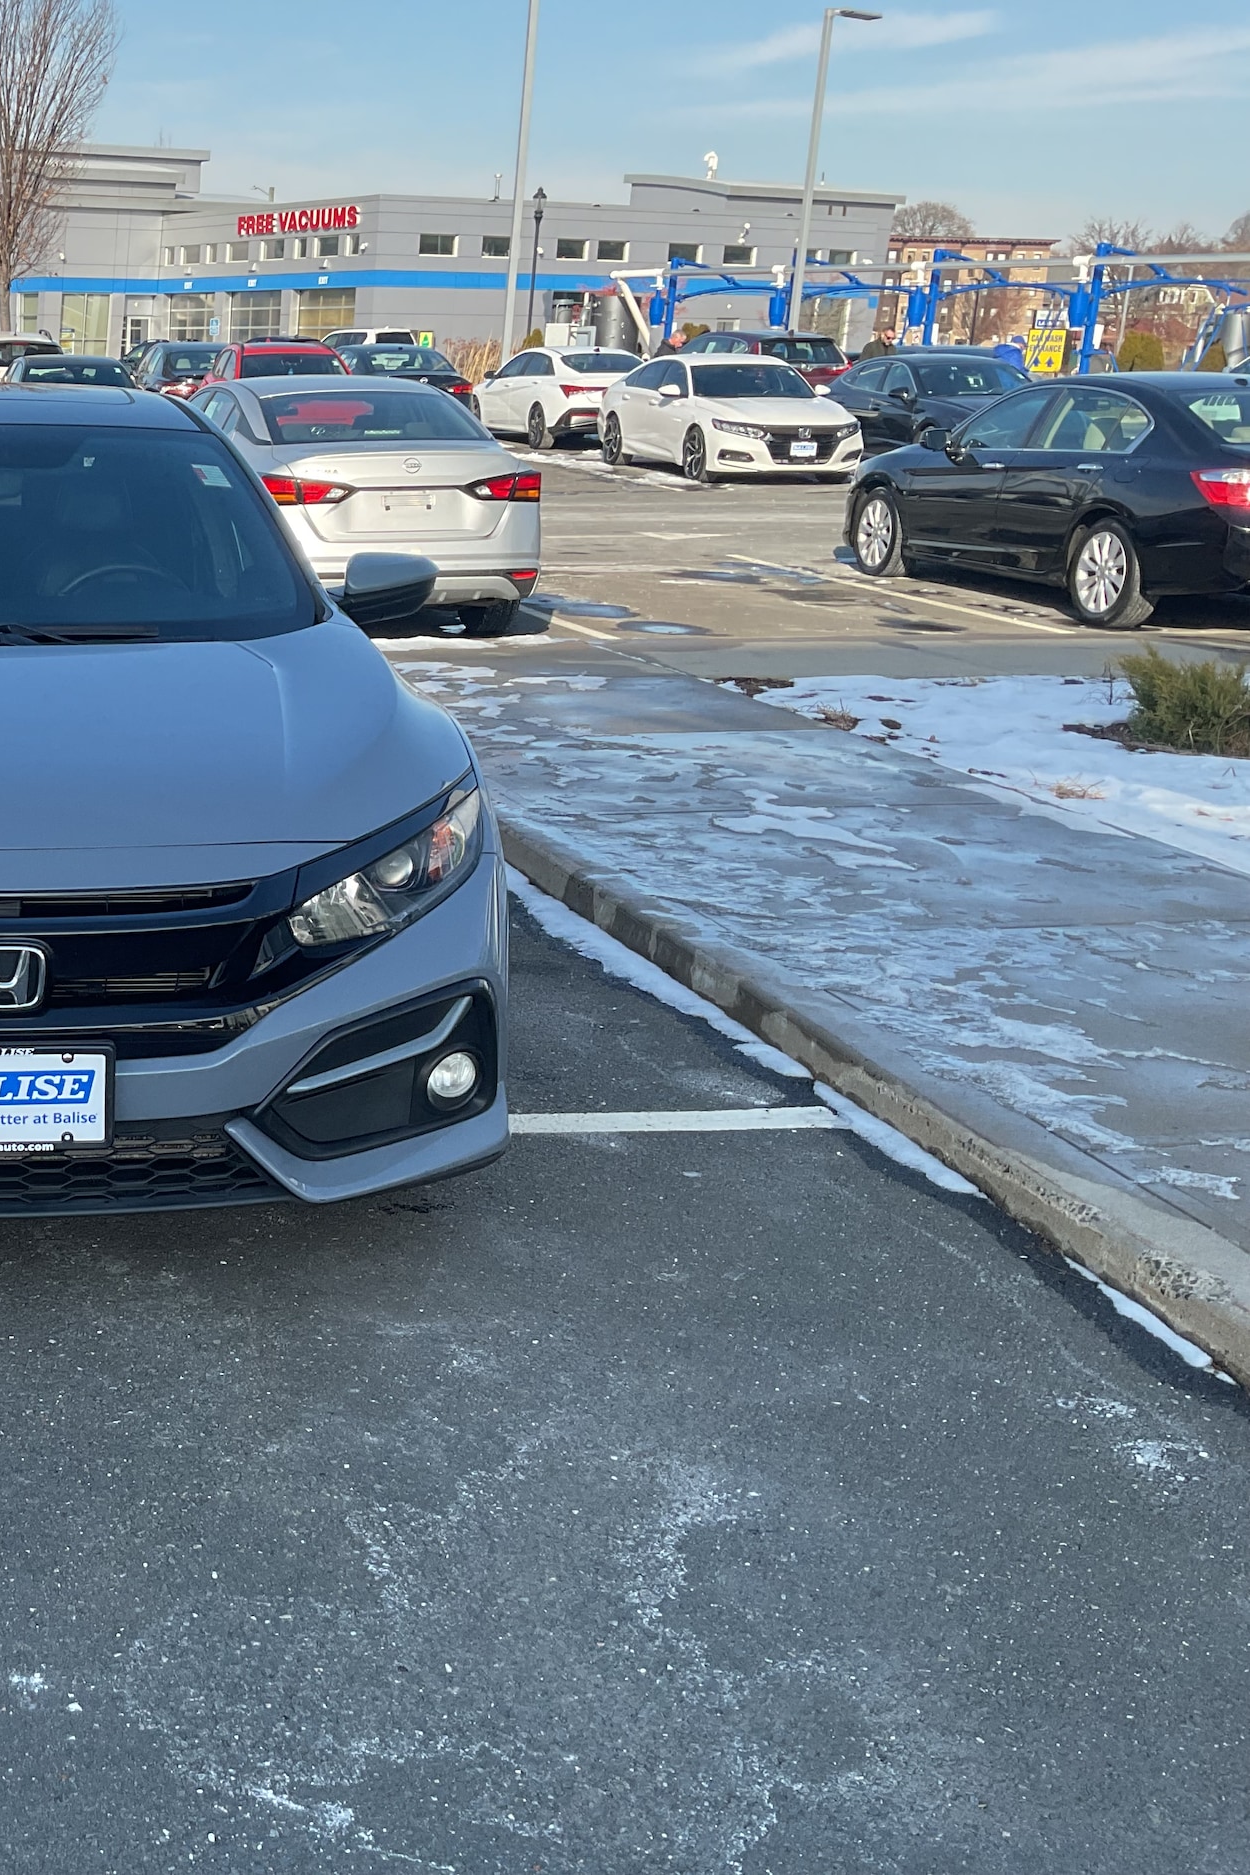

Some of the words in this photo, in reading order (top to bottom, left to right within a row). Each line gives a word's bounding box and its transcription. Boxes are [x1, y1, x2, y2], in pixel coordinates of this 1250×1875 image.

[238, 213, 277, 236] FREE
[279, 206, 361, 232] VACUUMS
[33, 1113, 48, 1124] at
[53, 1111, 97, 1124] Balise
